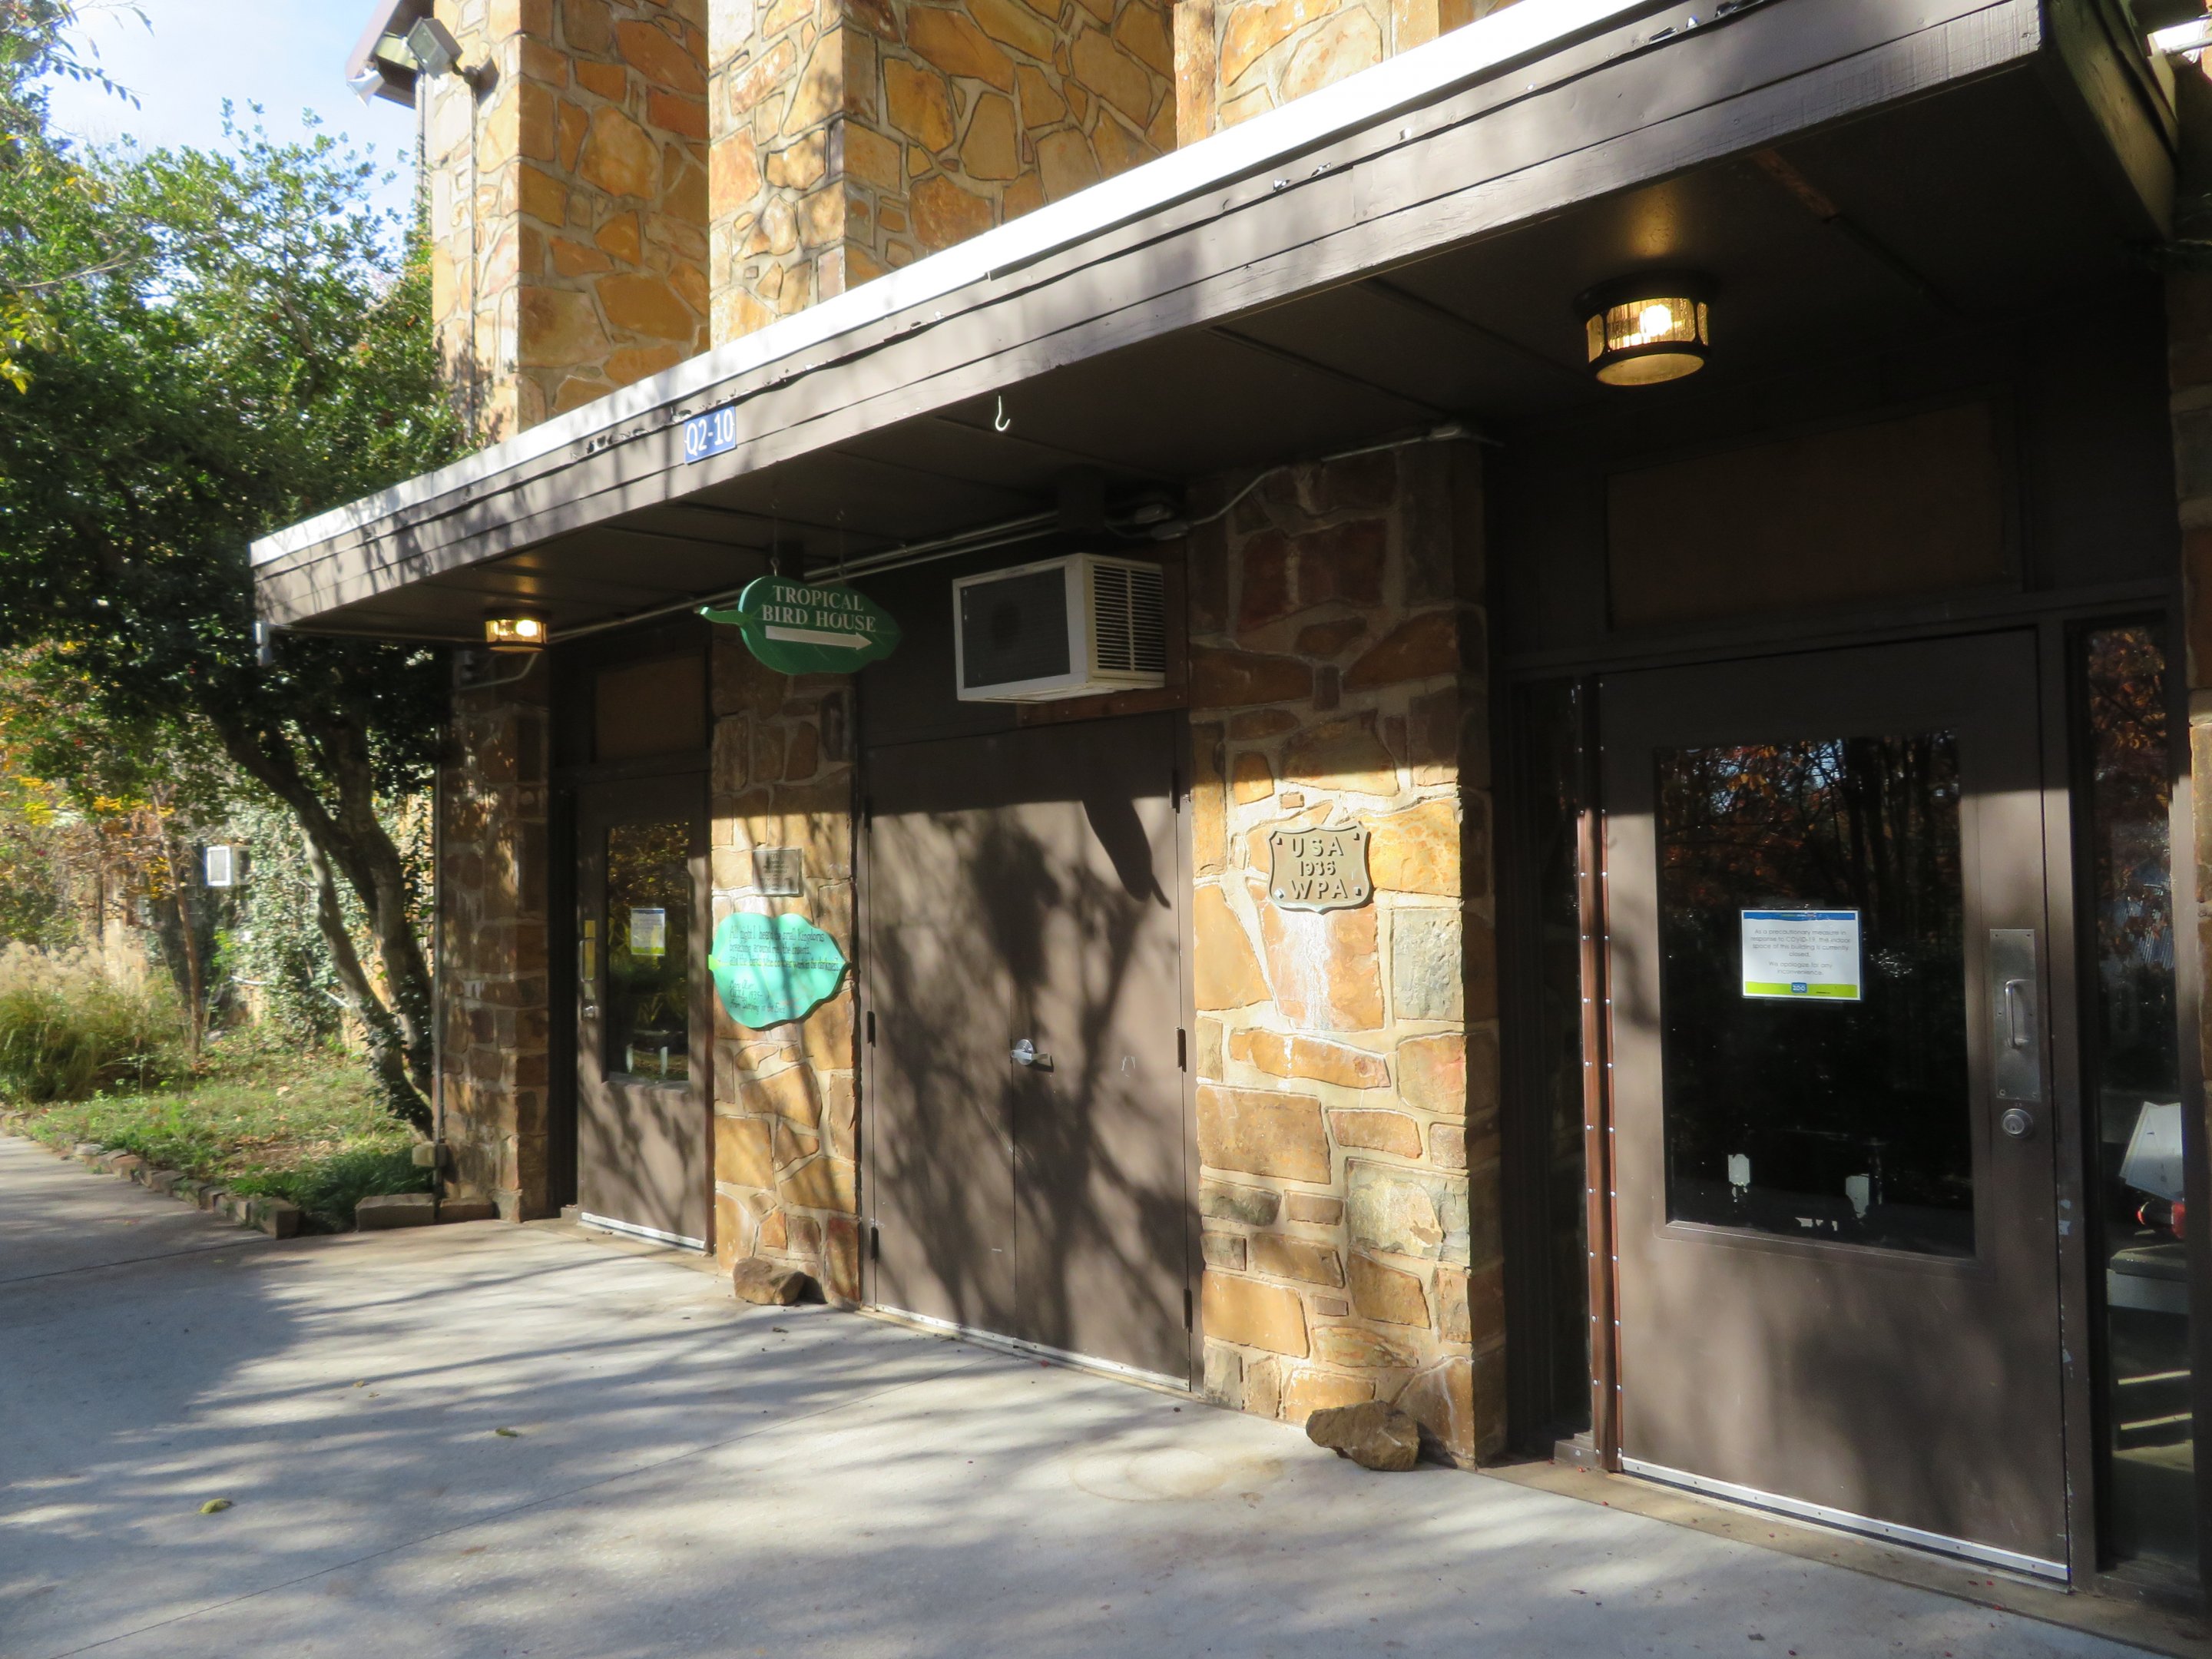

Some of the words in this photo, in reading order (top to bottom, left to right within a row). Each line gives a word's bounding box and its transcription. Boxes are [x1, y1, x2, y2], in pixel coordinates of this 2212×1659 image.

[685, 409, 734, 456] Q2-10
[772, 585, 863, 612] TROPICAL
[762, 604, 808, 625] BIRD
[816, 611, 876, 633] HOUSE
[1292, 836, 1344, 858] USA
[1300, 861, 1336, 877] 1936
[1291, 879, 1348, 899] WPA
